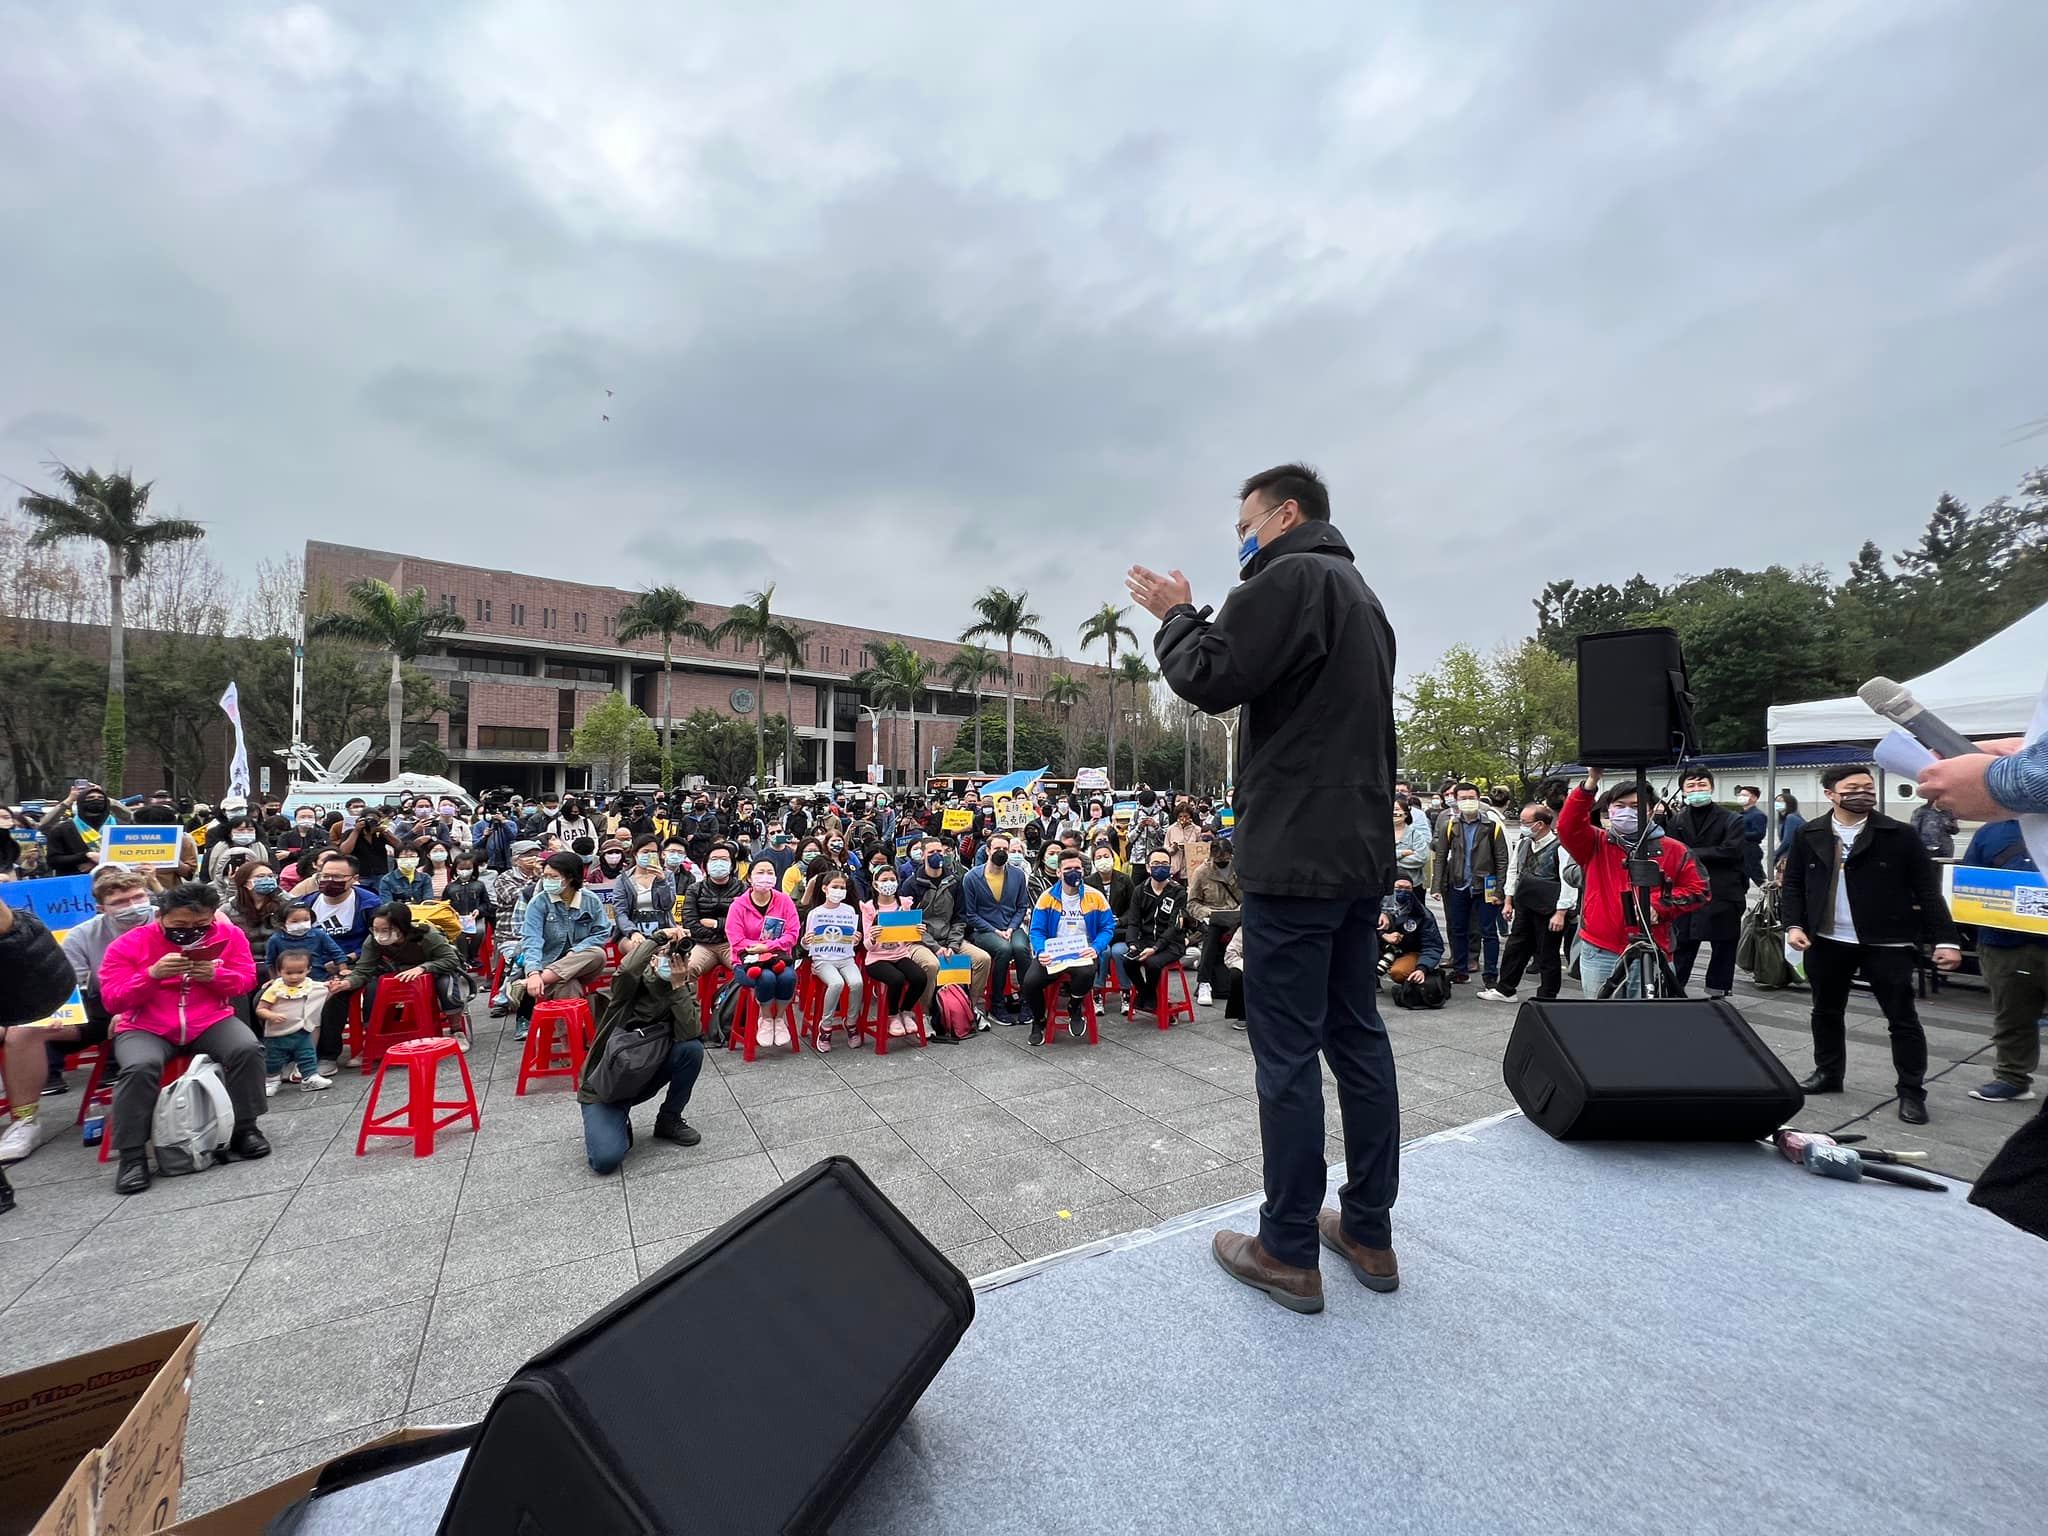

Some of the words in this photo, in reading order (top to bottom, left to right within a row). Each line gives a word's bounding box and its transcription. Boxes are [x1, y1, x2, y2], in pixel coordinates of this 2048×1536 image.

[119, 848, 133, 856] NO
[136, 848, 166, 856] PUTLER
[47, 894, 95, 914] with
[52, 1009, 73, 1018] NE
